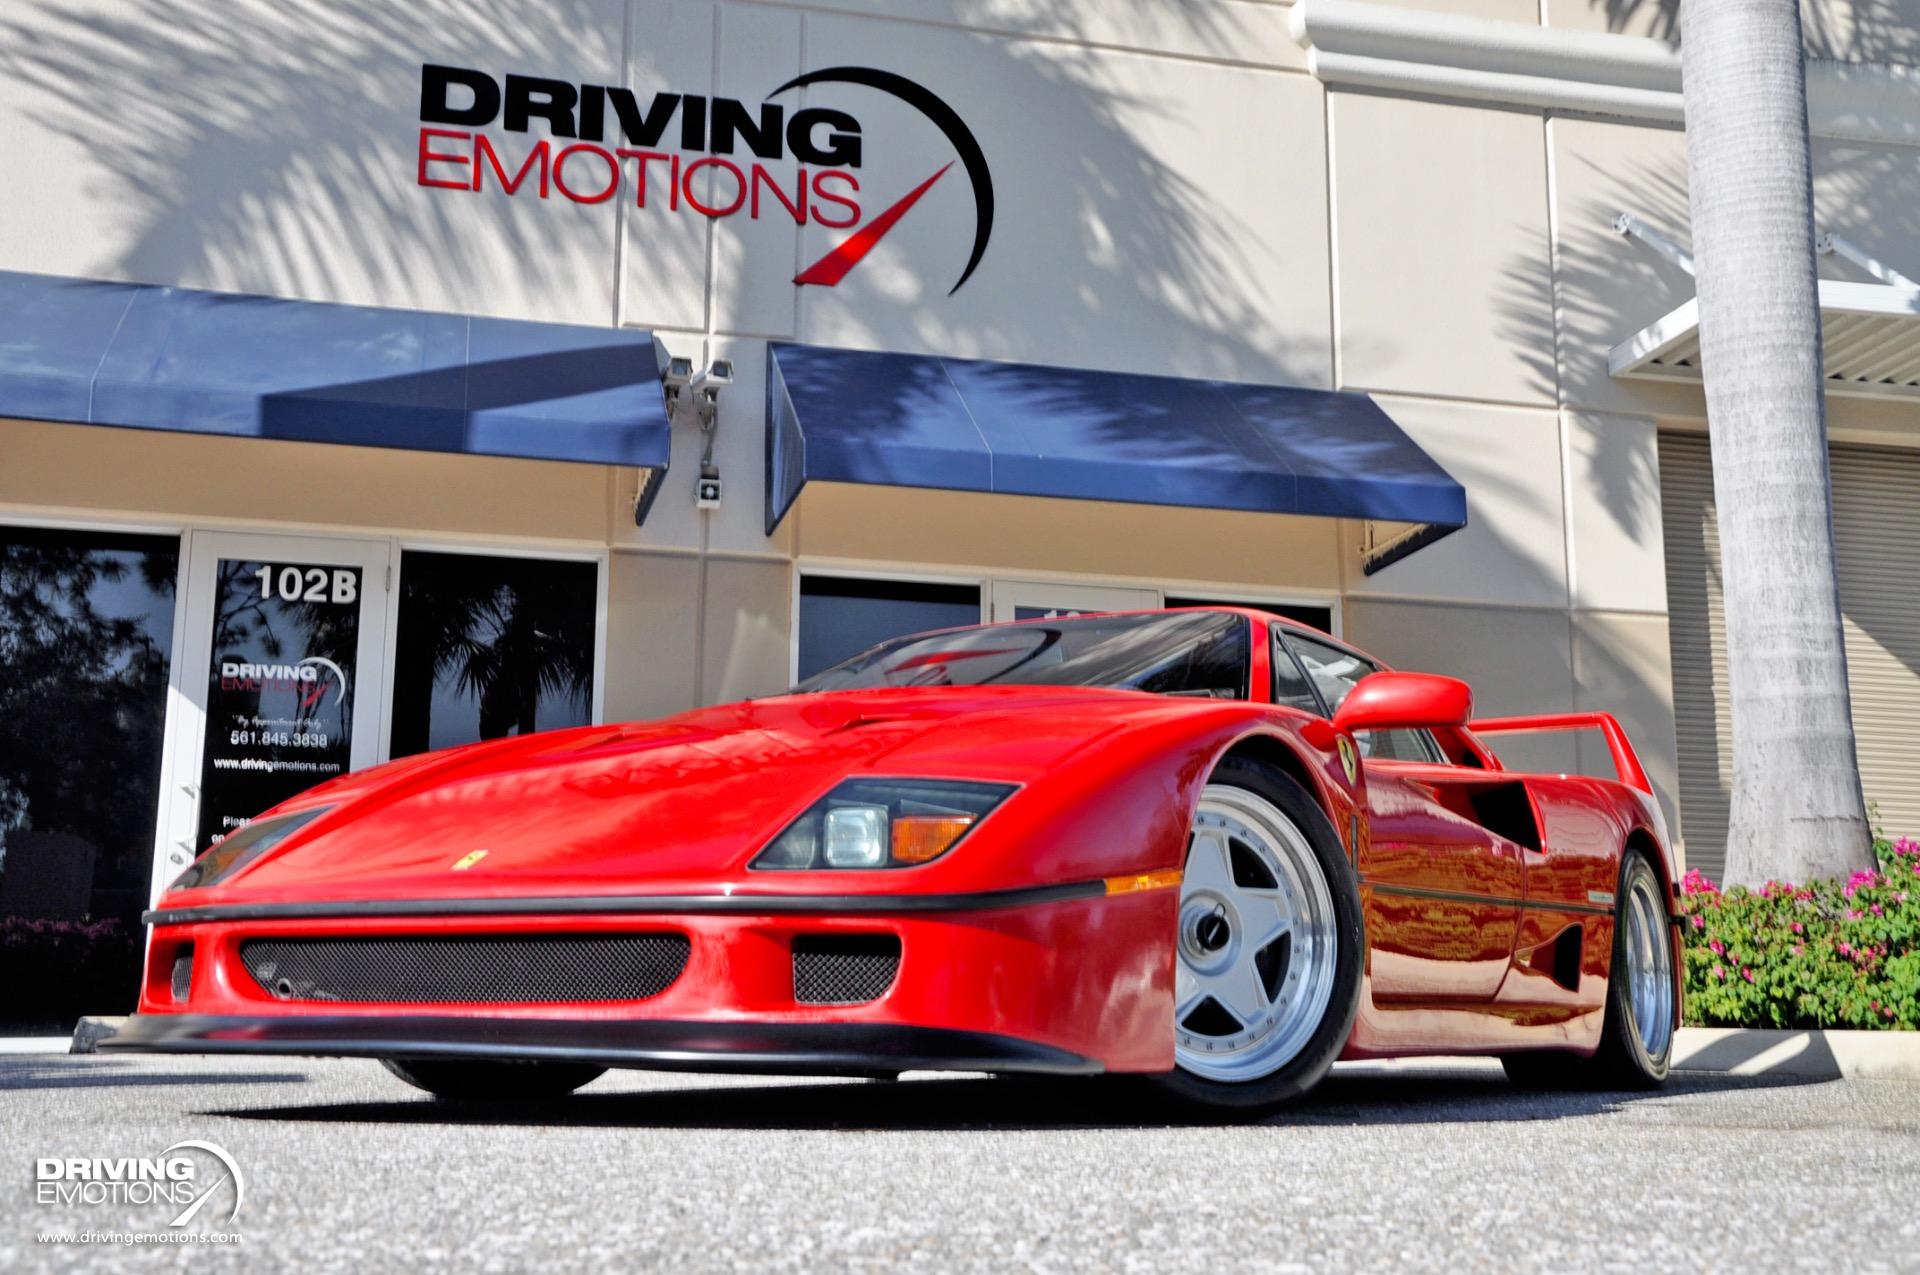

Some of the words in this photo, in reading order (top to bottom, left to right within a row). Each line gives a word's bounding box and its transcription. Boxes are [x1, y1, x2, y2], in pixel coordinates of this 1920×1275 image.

[419, 63, 862, 168] DRIVING
[417, 127, 862, 229] EMOTIONS
[255, 565, 357, 604] 102B
[222, 662, 317, 682] DRIVING
[230, 729, 328, 749] 561.845.3838
[214, 758, 340, 773] www.drivingemotions.com
